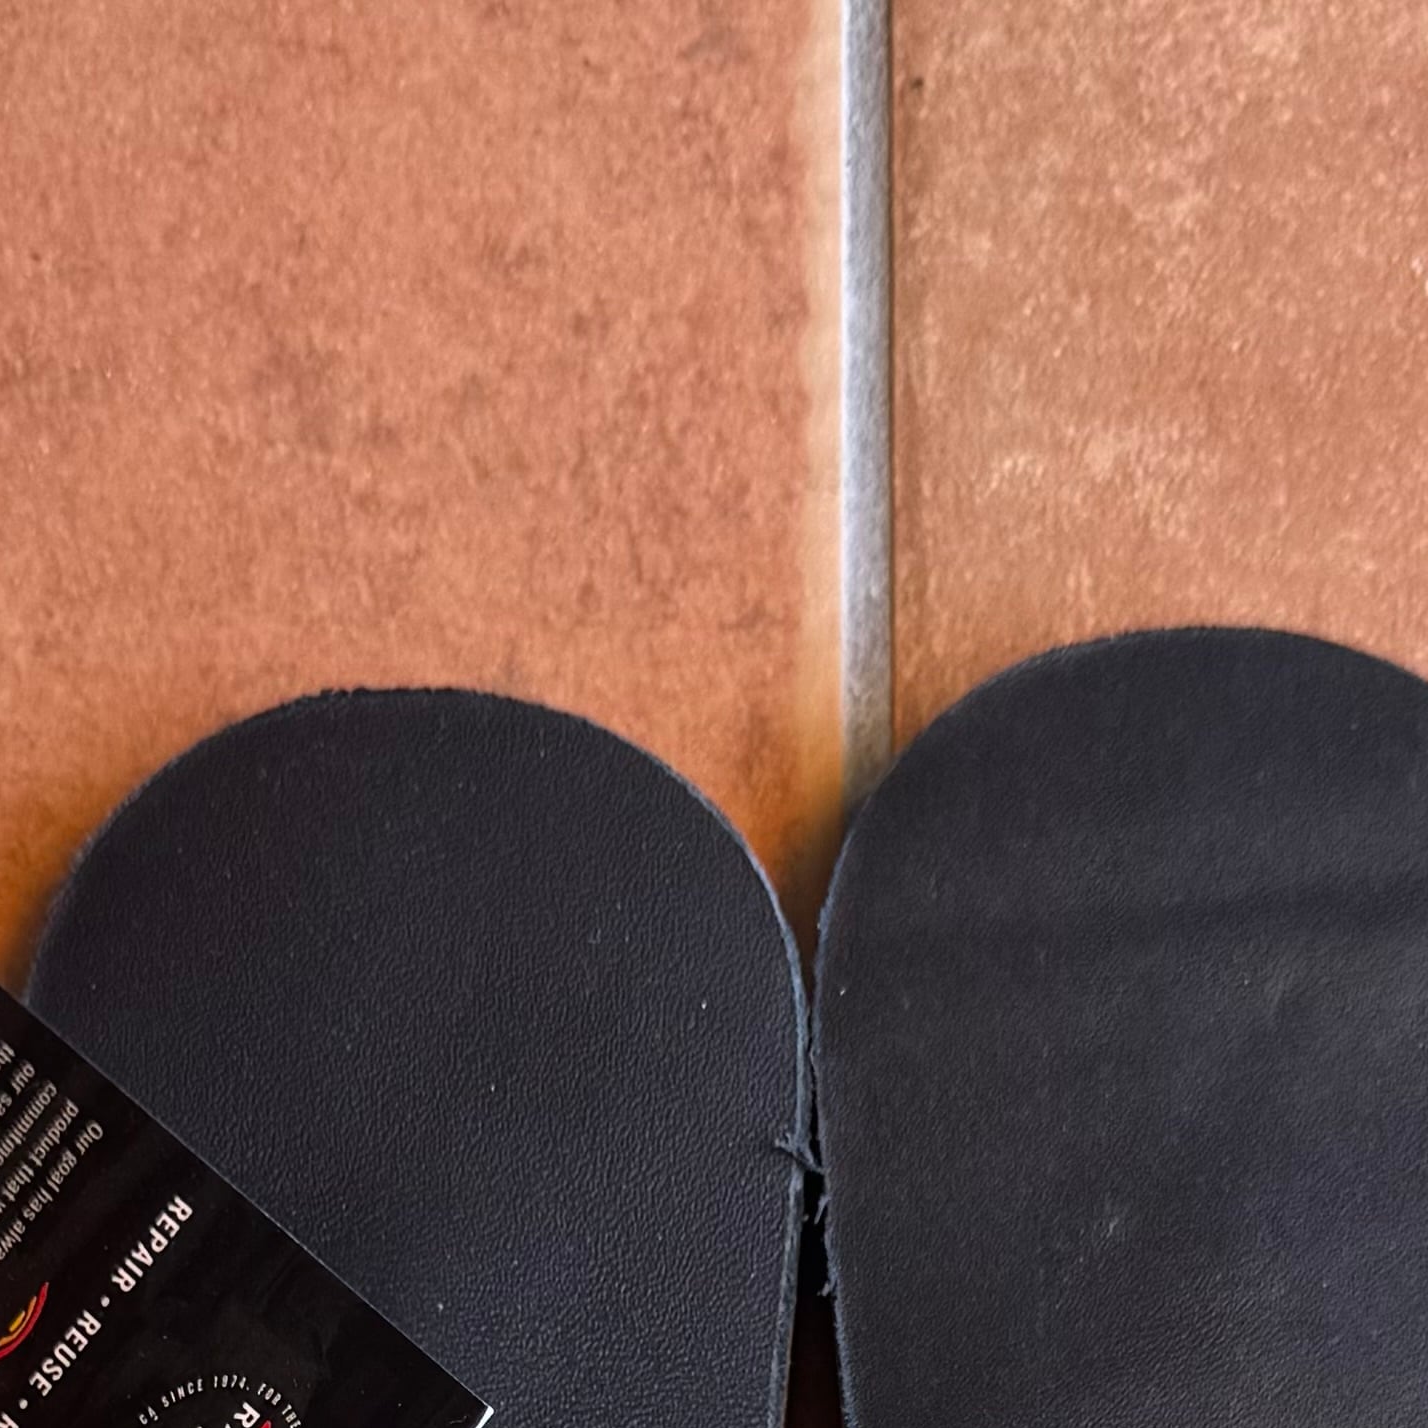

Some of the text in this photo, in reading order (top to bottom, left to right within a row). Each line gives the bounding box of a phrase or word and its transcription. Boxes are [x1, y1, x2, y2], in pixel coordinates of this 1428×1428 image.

[10, 1060, 35, 1095] our
[27, 1097, 79, 1167] product
[74, 1120, 104, 1155] Our
[0, 1161, 35, 1202] that
[45, 1148, 77, 1193] goal
[21, 1186, 53, 1221] has
[110, 1195, 193, 1292] REPAIR
[28, 1309, 101, 1396] REUSE
[162, 1378, 204, 1408] SINCE
[257, 1382, 282, 1405] FOR
